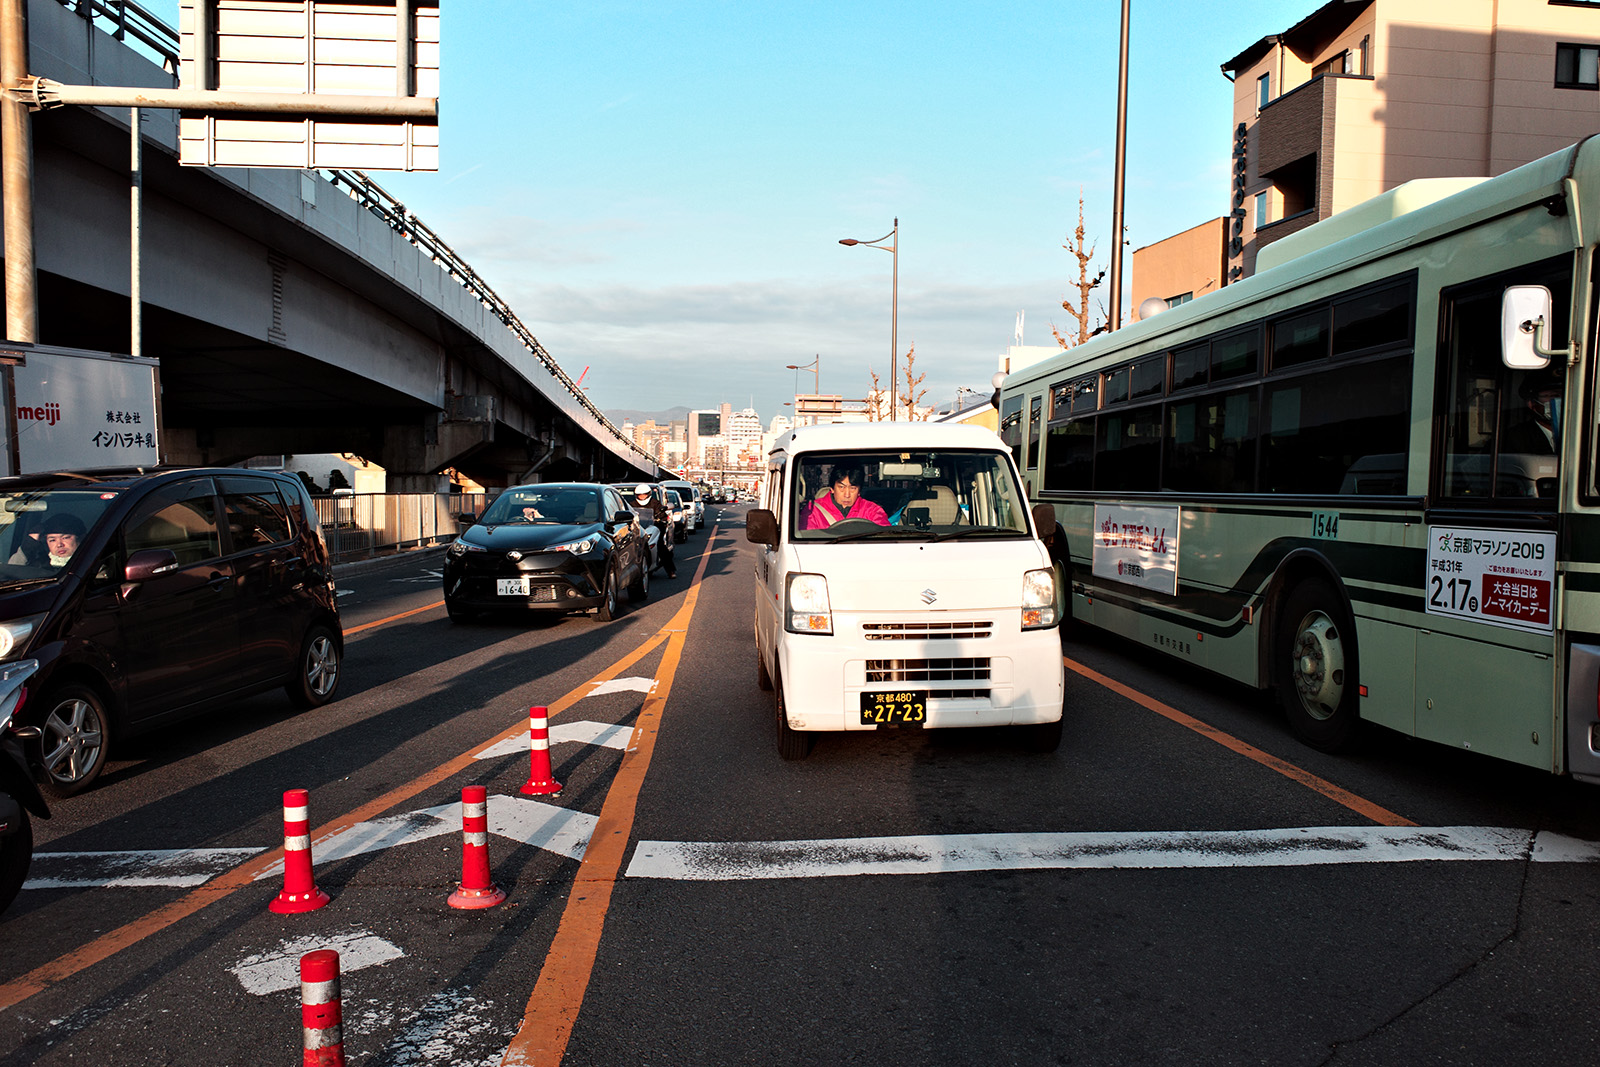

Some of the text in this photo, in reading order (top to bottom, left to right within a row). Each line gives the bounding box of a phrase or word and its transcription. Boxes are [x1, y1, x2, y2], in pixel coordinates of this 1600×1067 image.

[1231, 122, 1247, 256] Gojozaka
[17, 402, 61, 426] meiji
[105, 410, 141, 424] 株式会社
[92, 431, 156, 448] イシハラ牛乳
[1313, 514, 1338, 538] 1544
[1431, 559, 1463, 573] 平成31年
[505, 585, 528, 594] 16-40
[1493, 581, 1538, 599] 大会当日は
[1484, 596, 1547, 616] ノーマイカーデー
[863, 703, 924, 722] れ 27-23
